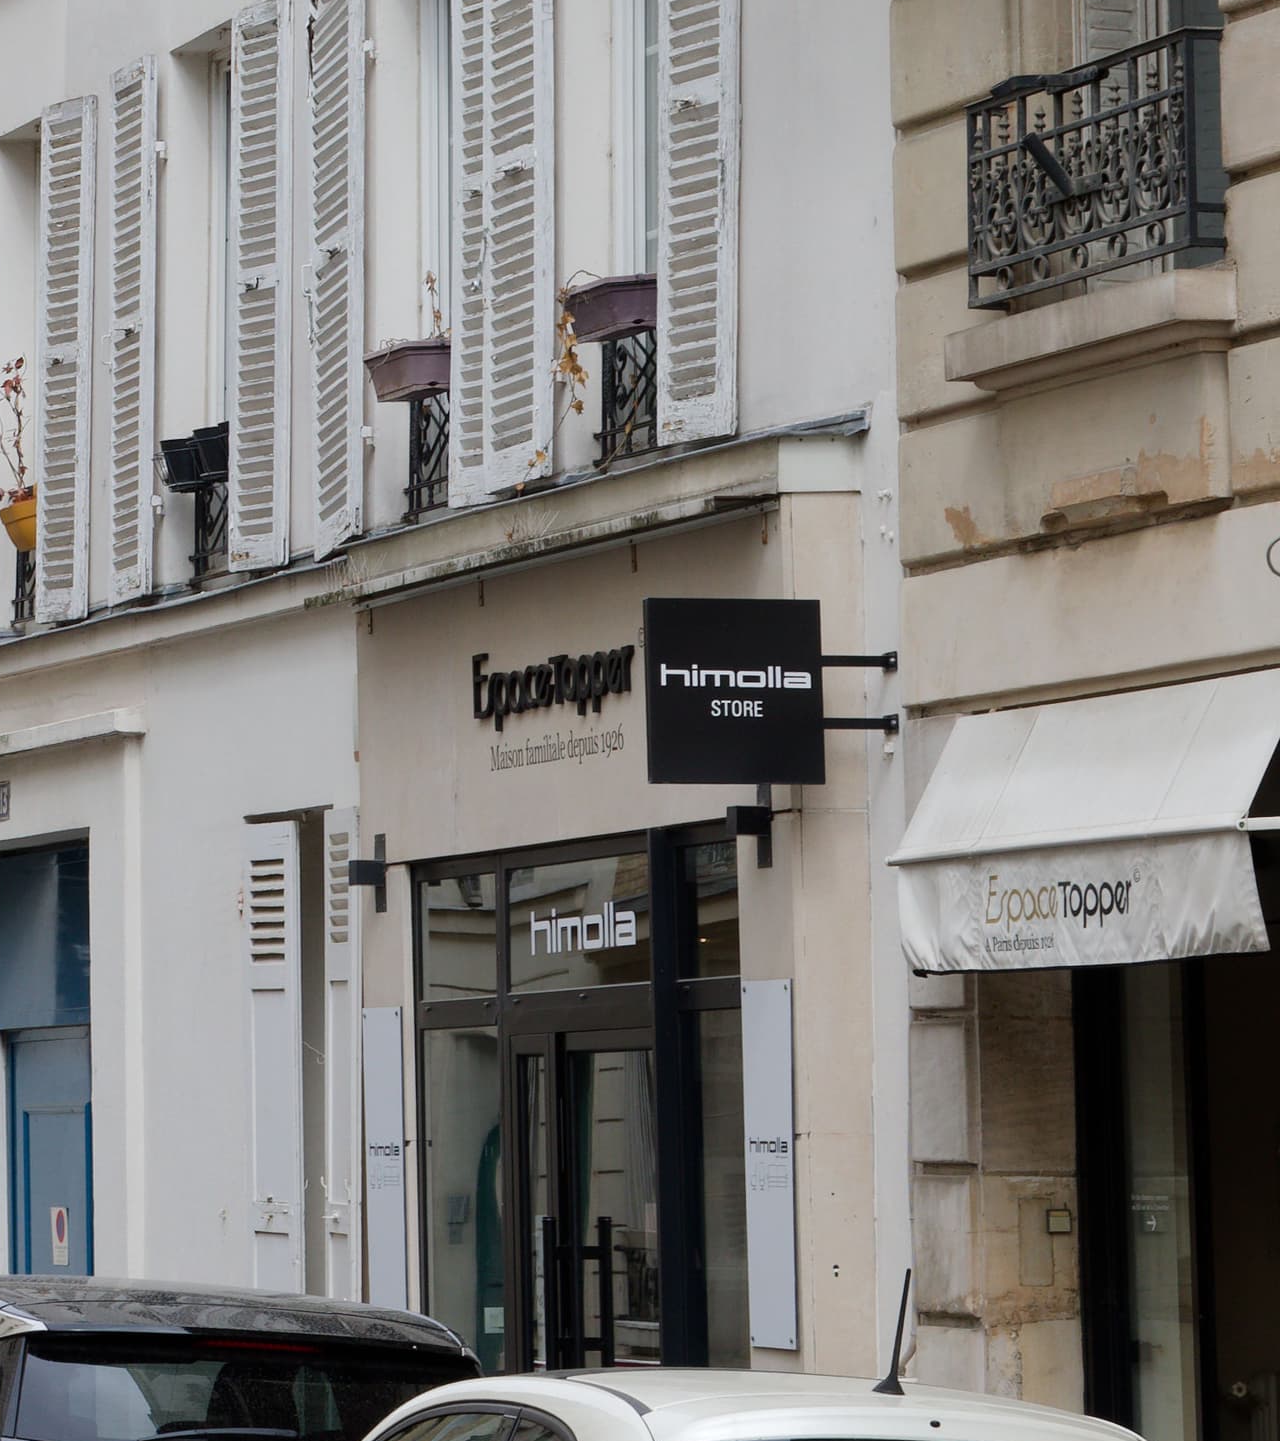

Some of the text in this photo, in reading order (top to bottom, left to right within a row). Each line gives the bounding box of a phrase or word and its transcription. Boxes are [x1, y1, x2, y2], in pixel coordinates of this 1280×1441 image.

[660, 663, 812, 689] himolla
[711, 700, 764, 717] STORE
[490, 723, 625, 771] Maison familiale depuis 1926
[530, 901, 637, 956] himolla
[749, 1136, 788, 1153] himolla
